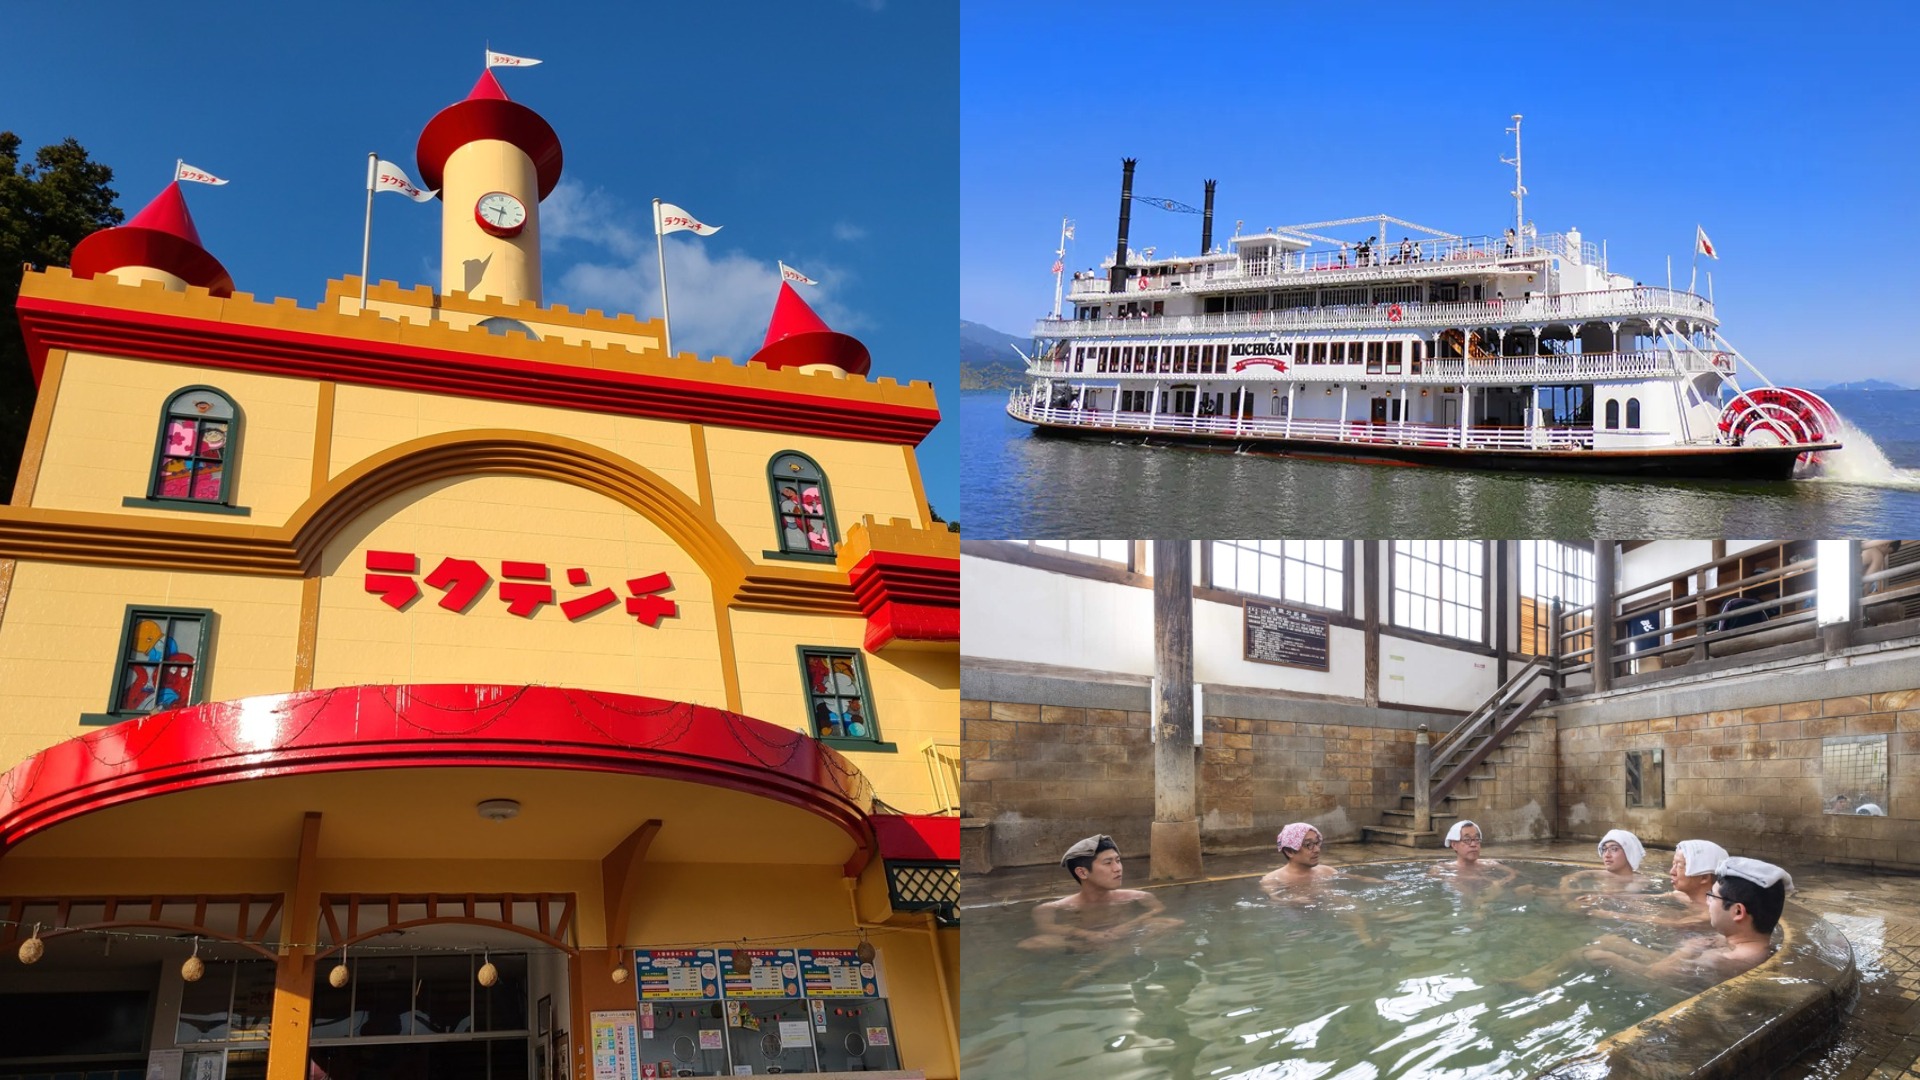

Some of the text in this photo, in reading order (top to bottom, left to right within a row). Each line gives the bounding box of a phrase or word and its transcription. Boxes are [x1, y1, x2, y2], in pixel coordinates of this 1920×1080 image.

[494, 55, 521, 65] ラクテンチ
[181, 170, 219, 184] ラクテンチ
[380, 174, 421, 197] ラクテンチ
[664, 216, 703, 231] ラクテンチ
[785, 270, 809, 283] ラクテンチ
[1231, 342, 1293, 356] MICHIGAN
[365, 550, 677, 627] ラクテンチ
[731, 1015, 739, 1025] 2
[816, 1014, 824, 1023] 3
